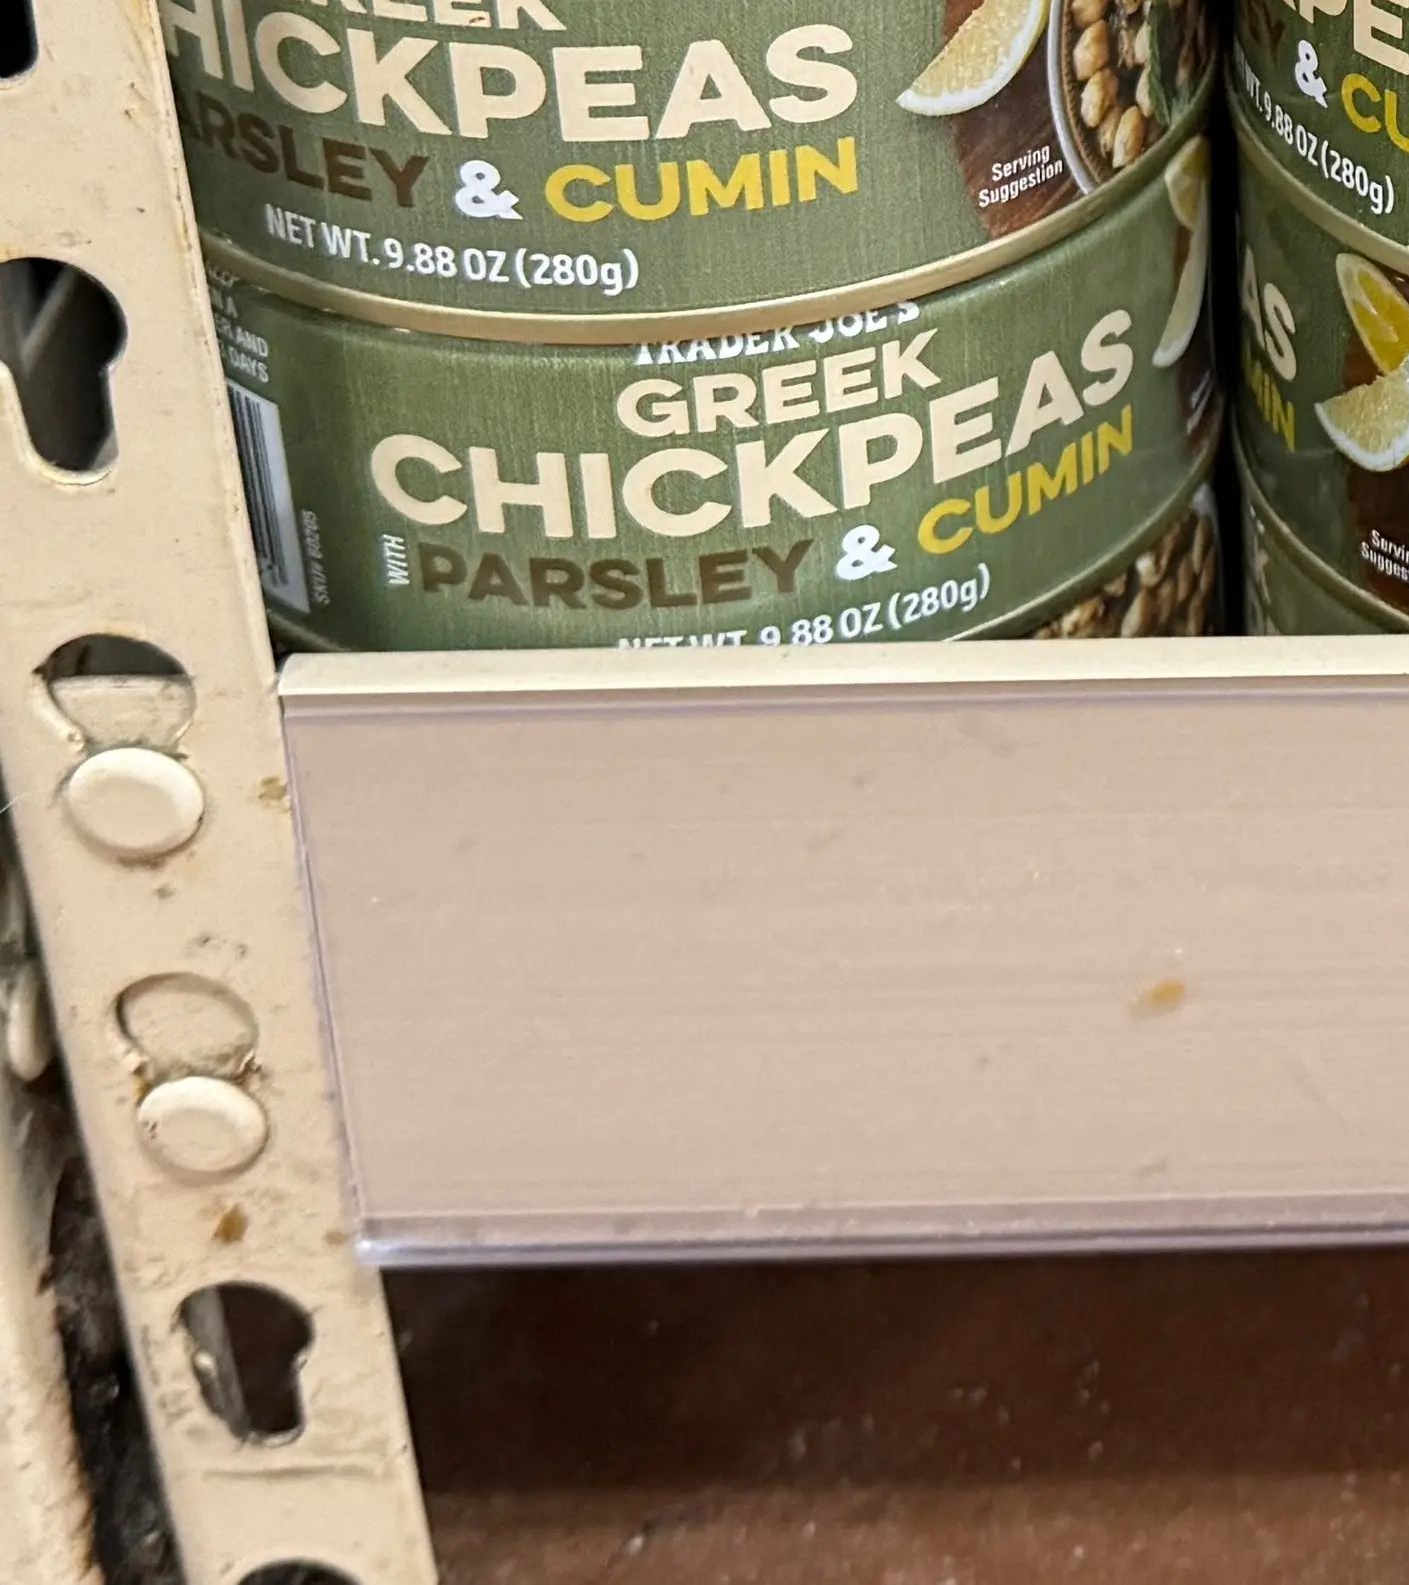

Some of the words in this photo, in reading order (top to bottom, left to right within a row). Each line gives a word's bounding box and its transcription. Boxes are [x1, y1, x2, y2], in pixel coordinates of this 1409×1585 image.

[1293, 39, 1328, 108] &
[453, 159, 523, 220] &
[543, 135, 859, 223] CUMIN
[978, 157, 1064, 208] Suggestion
[991, 144, 1051, 182] Serving
[1320, 145, 1395, 215] (280g)
[264, 202, 317, 249] NET
[320, 222, 380, 267] WT.
[383, 228, 455, 278] 9.88
[463, 244, 510, 285] OZ
[514, 247, 640, 297] (280g)
[616, 327, 941, 439] GREEK
[371, 309, 1133, 540] CHICKPEAS
[417, 538, 814, 611] PARSLEY
[835, 524, 899, 581] &
[915, 403, 1134, 555] CUMIN
[381, 534, 405, 586] WITH
[840, 603, 883, 639] OZ
[888, 562, 991, 630] (280g)
